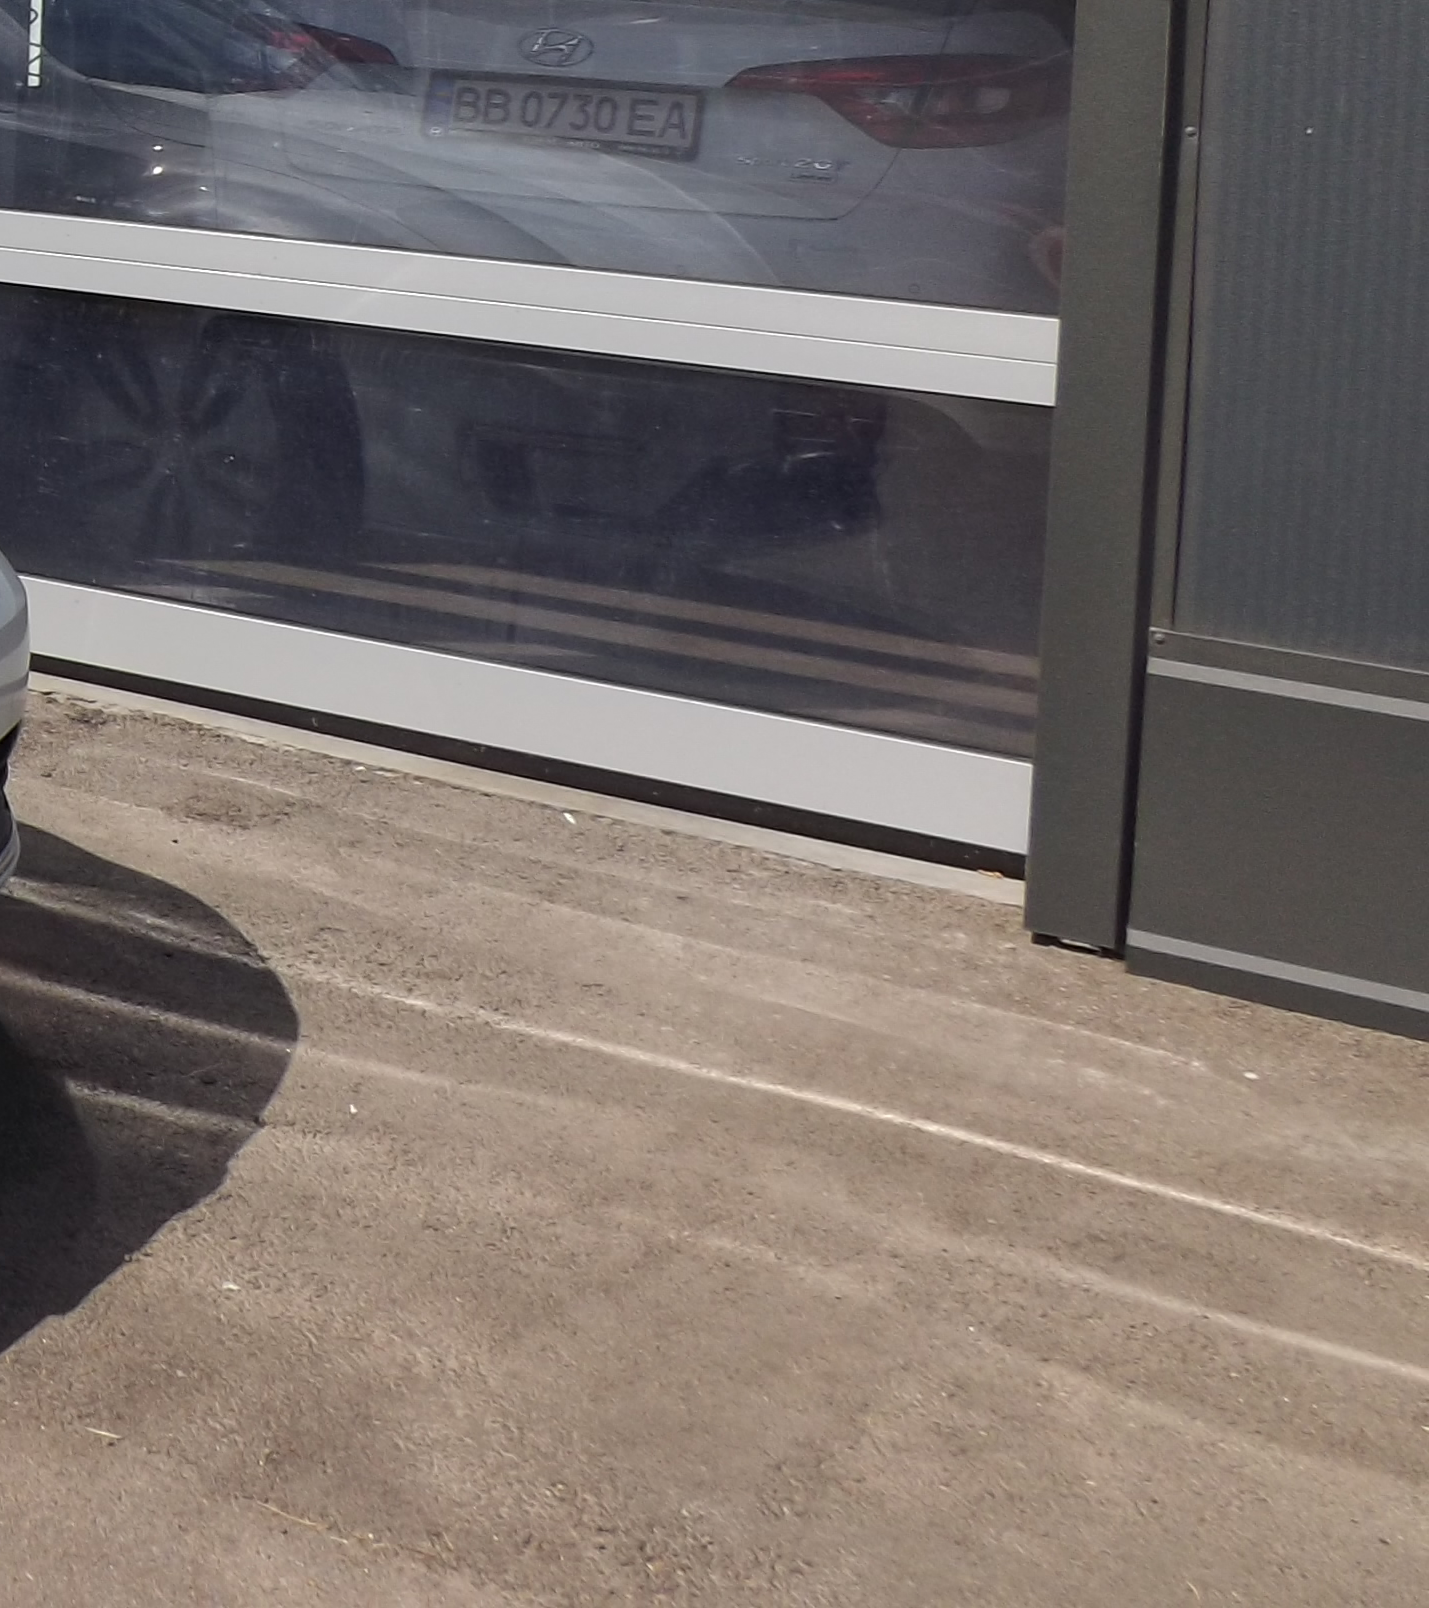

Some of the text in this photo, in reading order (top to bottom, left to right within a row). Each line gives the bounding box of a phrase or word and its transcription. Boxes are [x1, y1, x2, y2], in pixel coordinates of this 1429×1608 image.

[452, 86, 687, 140] BB 0730 EA
